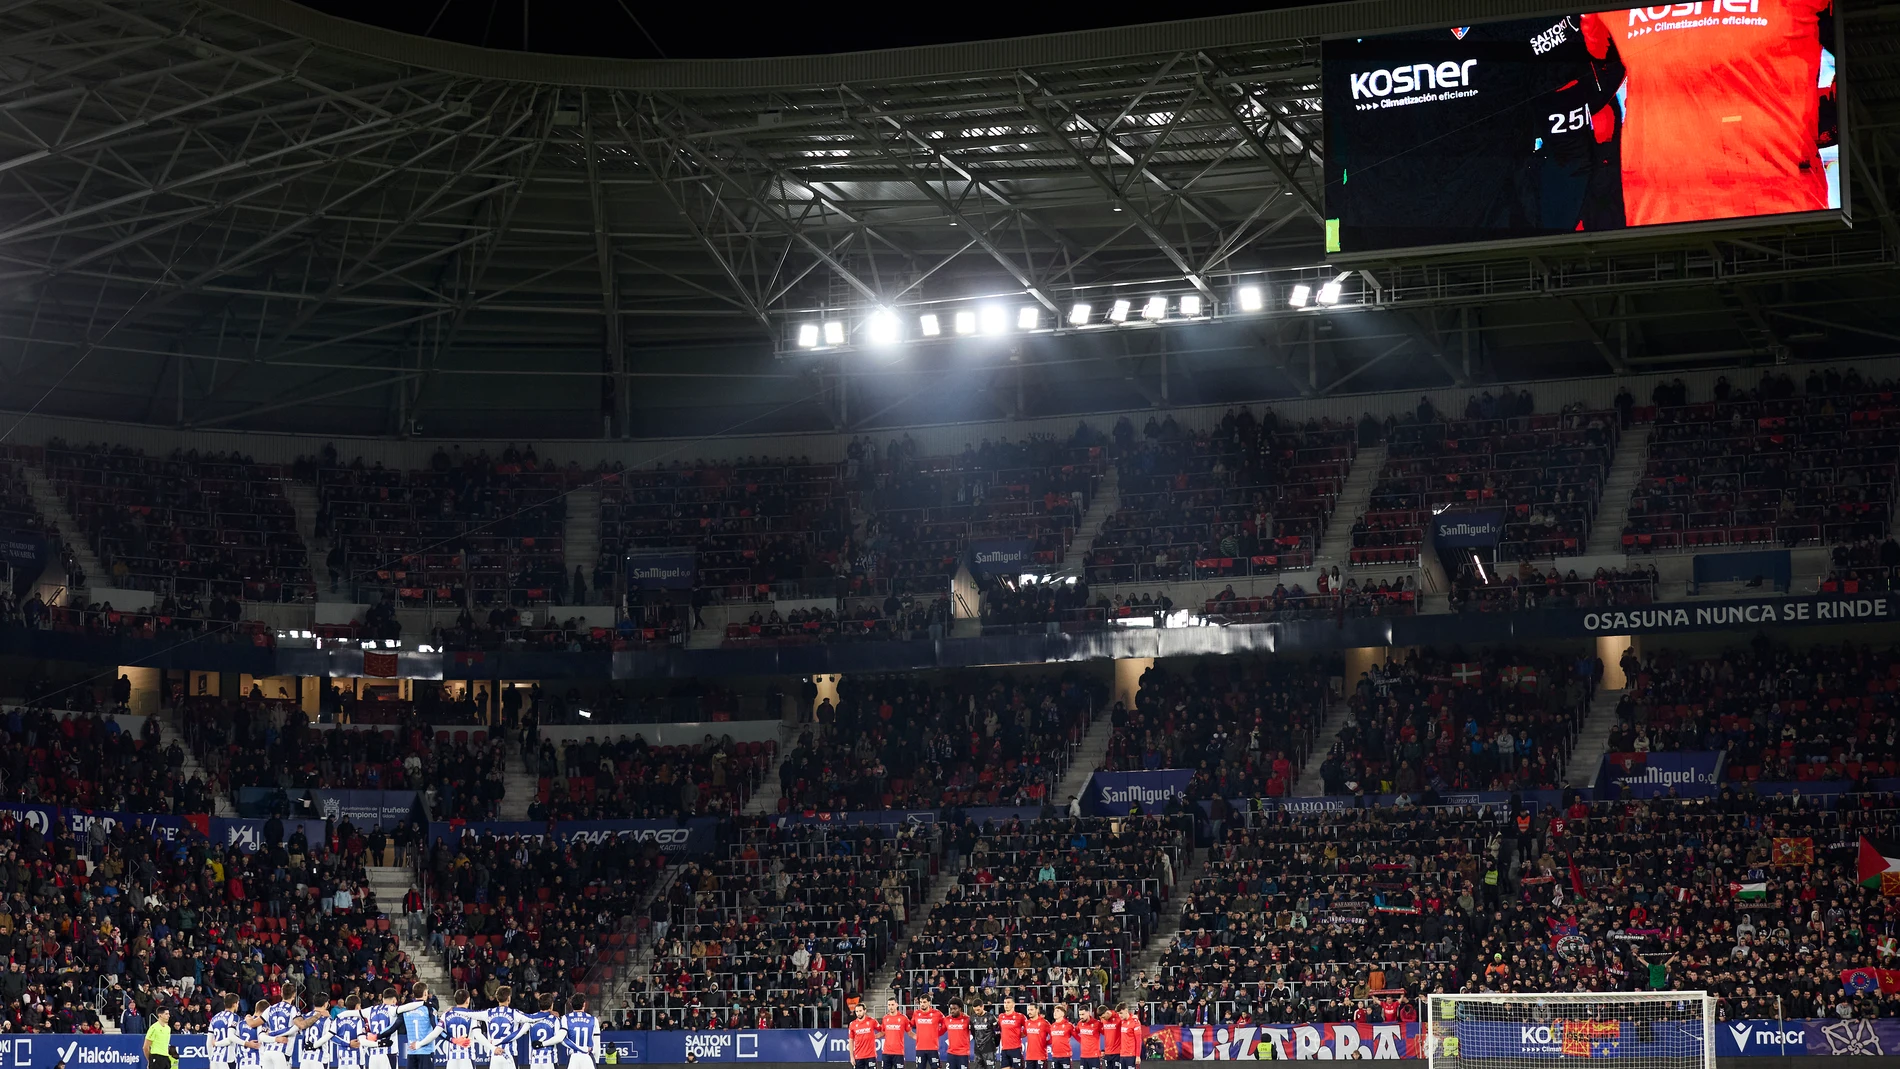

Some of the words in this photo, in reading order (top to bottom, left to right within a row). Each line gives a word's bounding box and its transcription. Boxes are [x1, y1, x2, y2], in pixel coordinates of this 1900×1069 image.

[1530, 19, 1567, 47] SALTOKI
[1655, 17, 1718, 33] Climatización
[1721, 15, 1768, 28] eficiente
[1533, 32, 1567, 56] HOME
[1380, 94, 1438, 109] Climatización
[1438, 89, 1479, 102] eficiente
[1583, 609, 1690, 631] OSASUNA
[1696, 604, 1777, 625] NUNCA
[1783, 602, 1810, 621] SE
[1817, 599, 1888, 619] RINDE
[341, 811, 378, 820] Pamplona
[382, 806, 410, 814] Iruñeko
[272, 1015, 286, 1031] 16
[412, 1019, 420, 1040] 1
[449, 1023, 467, 1039] 10
[490, 1022, 511, 1041] 23
[213, 1027, 227, 1042] 21
[536, 1028, 547, 1043] 2
[573, 1027, 589, 1048] 11
[685, 1035, 731, 1047] SALTOKI
[78, 1046, 120, 1063] Halcón
[120, 1054, 140, 1065] viajes
[686, 1046, 721, 1058] HOME
